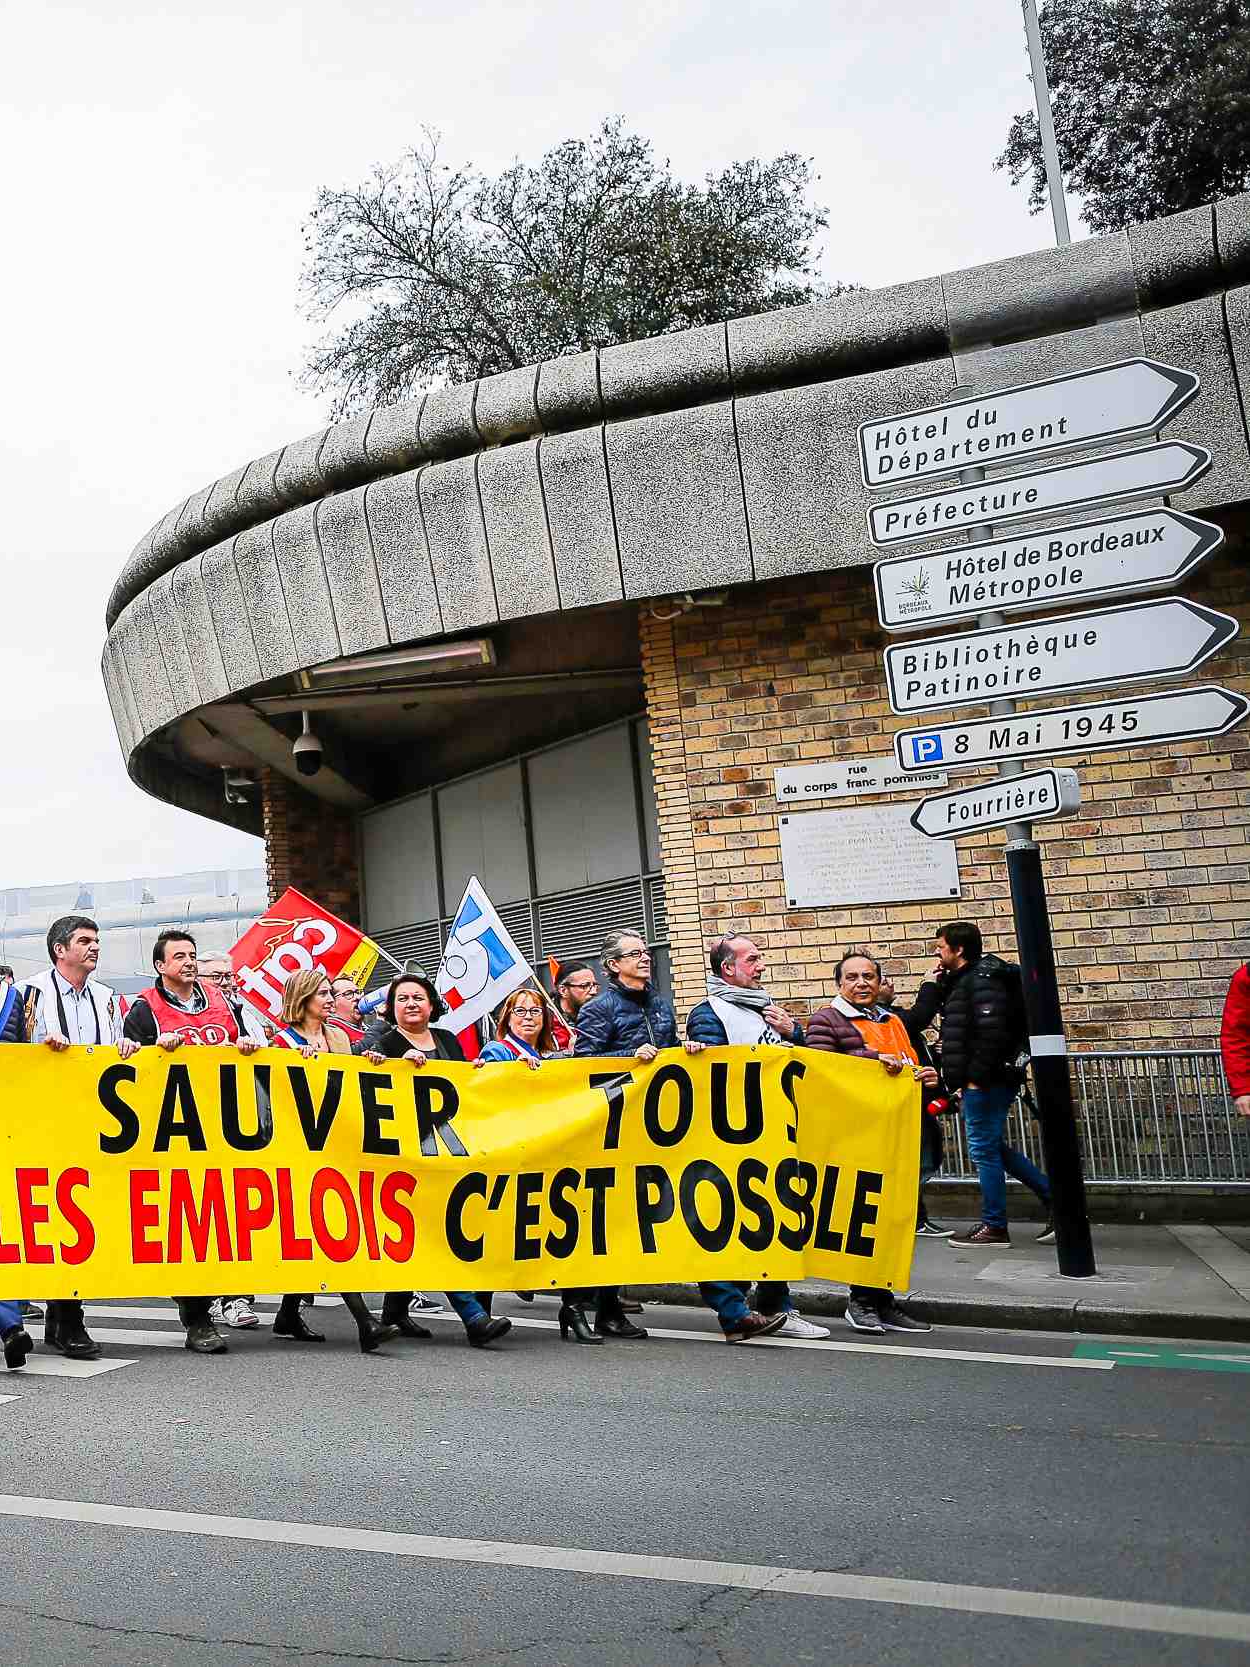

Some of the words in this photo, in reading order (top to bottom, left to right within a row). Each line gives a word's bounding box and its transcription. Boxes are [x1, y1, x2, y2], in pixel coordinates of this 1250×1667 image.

[874, 416, 949, 451] Hôtel
[966, 407, 998, 431] du
[877, 416, 1069, 475] Département
[884, 486, 1039, 533] Préfecture
[945, 551, 1007, 581] Hôtel
[1013, 546, 1042, 569] de
[1047, 524, 1166, 562] Bordeaux
[948, 564, 1084, 606] Métropole
[902, 627, 1099, 676] Bibliothèque
[906, 663, 1043, 701] Patinoire
[917, 738, 938, 761] P
[953, 733, 970, 755] 8
[988, 721, 1043, 751] Mai
[1060, 709, 1140, 742] 1945
[782, 784, 798, 794] du
[804, 781, 838, 793] corps
[846, 777, 877, 790] franc
[847, 766, 868, 776] rue
[946, 786, 1050, 825] Fourrière
[97, 1062, 469, 1158] SAUVER
[129, 1166, 418, 1265] EMPLOIS
[634, 1156, 884, 1258] POSSBLE
